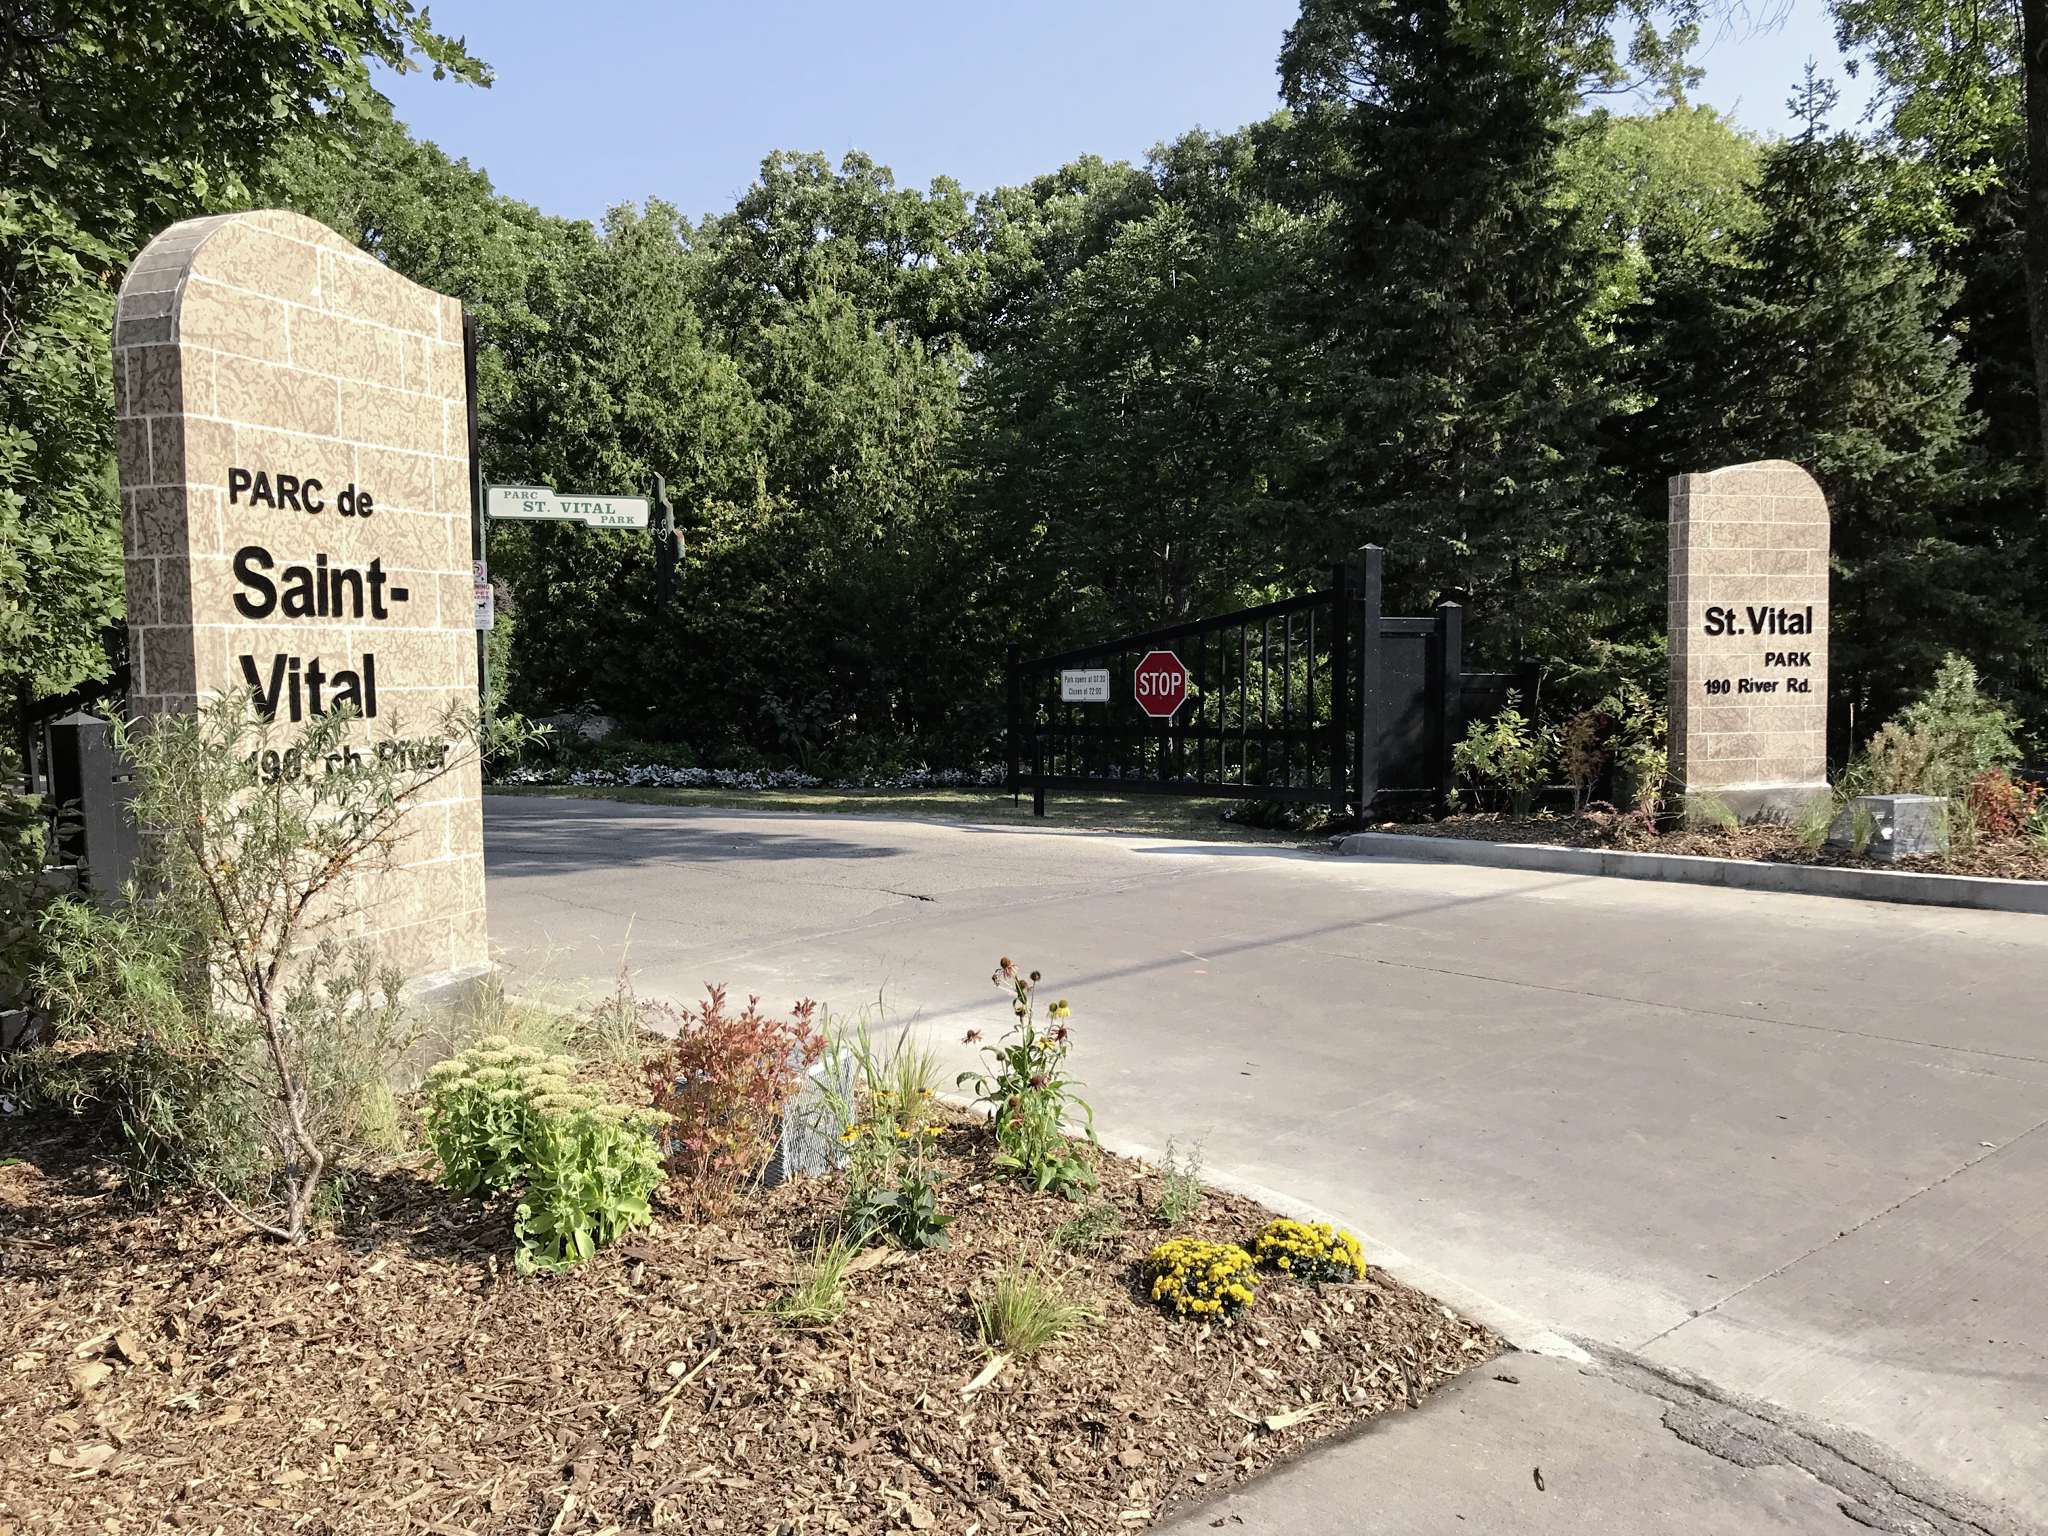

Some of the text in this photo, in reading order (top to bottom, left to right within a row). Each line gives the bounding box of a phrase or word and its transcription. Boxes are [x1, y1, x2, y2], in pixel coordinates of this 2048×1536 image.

[228, 467, 374, 518] PARC de
[504, 490, 538, 500] PARC
[523, 501, 616, 515] ST. VITAL
[601, 515, 635, 525] PARK
[232, 545, 409, 620] Saint-
[1746, 606, 1813, 636] Vital
[1764, 652, 1812, 667] PARK
[238, 653, 377, 723] Vital
[1139, 671, 1182, 696] STOP
[1704, 678, 1812, 694] 190 River Rd.
